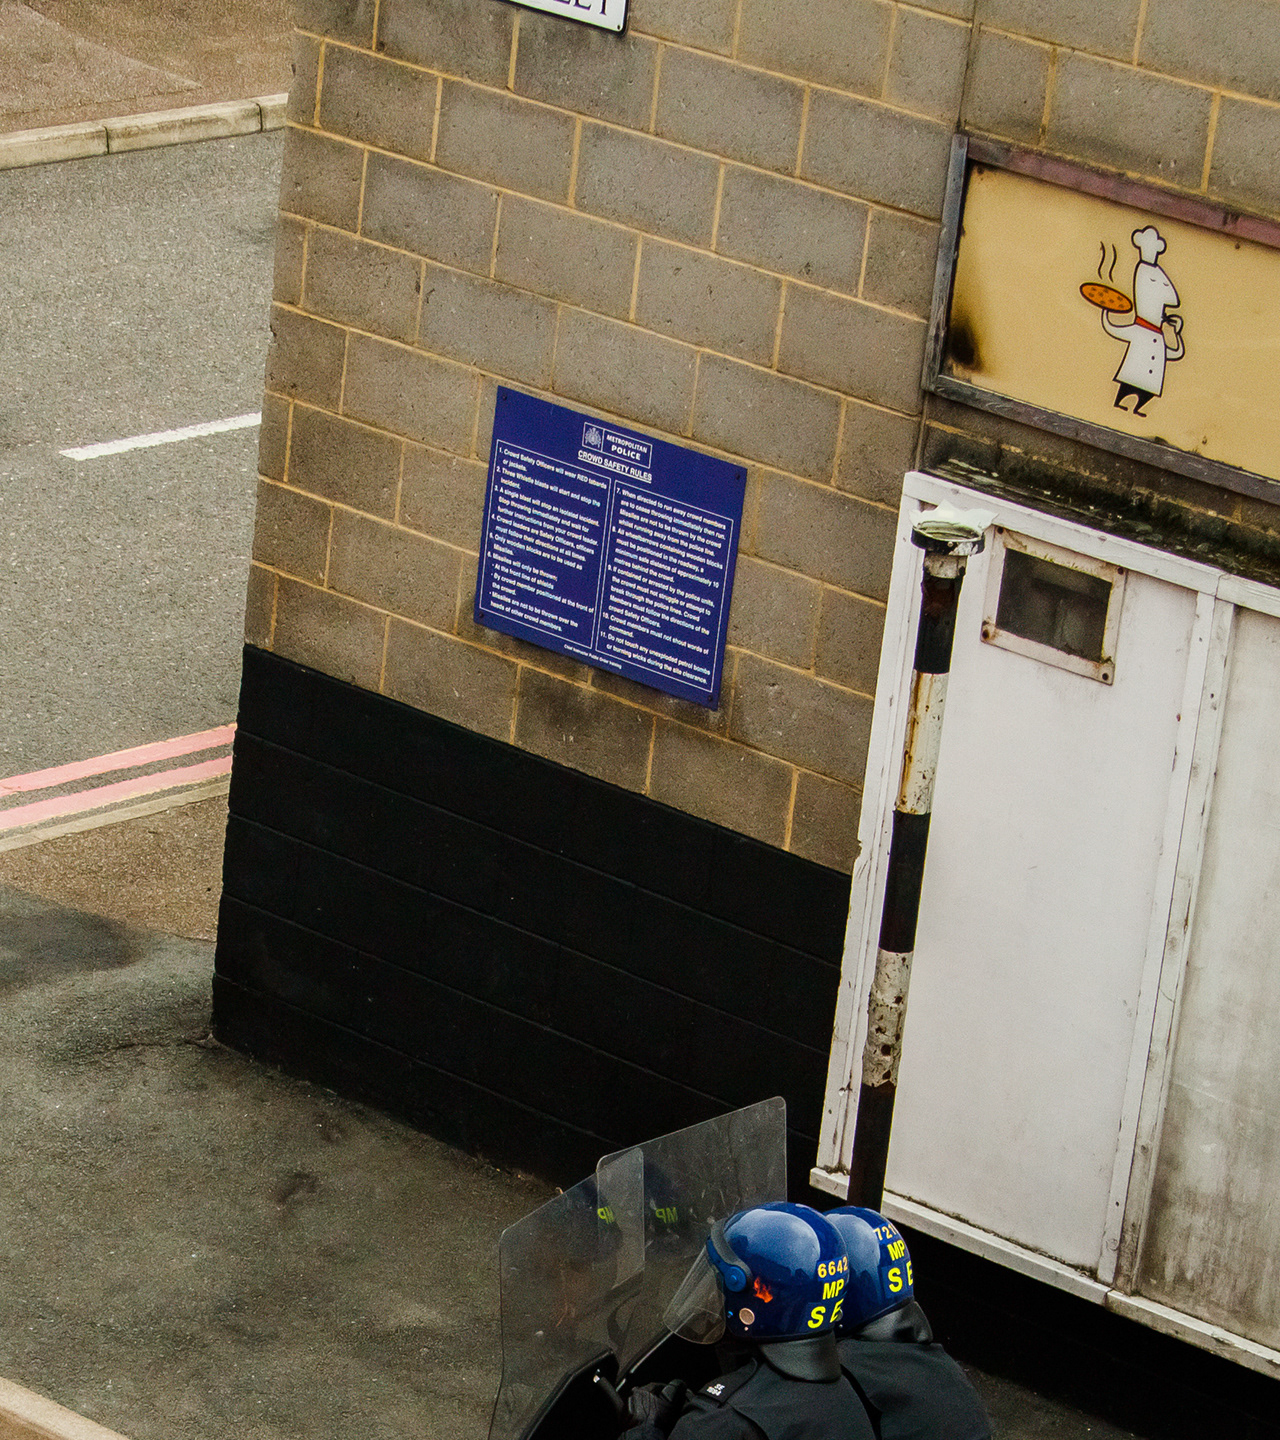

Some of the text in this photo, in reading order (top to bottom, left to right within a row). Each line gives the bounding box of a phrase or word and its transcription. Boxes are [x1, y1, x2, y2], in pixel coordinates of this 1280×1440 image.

[606, 434, 647, 453] METROPOLITAN
[611, 444, 640, 460] POLICE
[577, 449, 652, 481] CROWD SAFETY RULES
[886, 1239, 906, 1261] MP
[817, 1256, 849, 1278] 6642
[822, 1279, 845, 1300] MP
